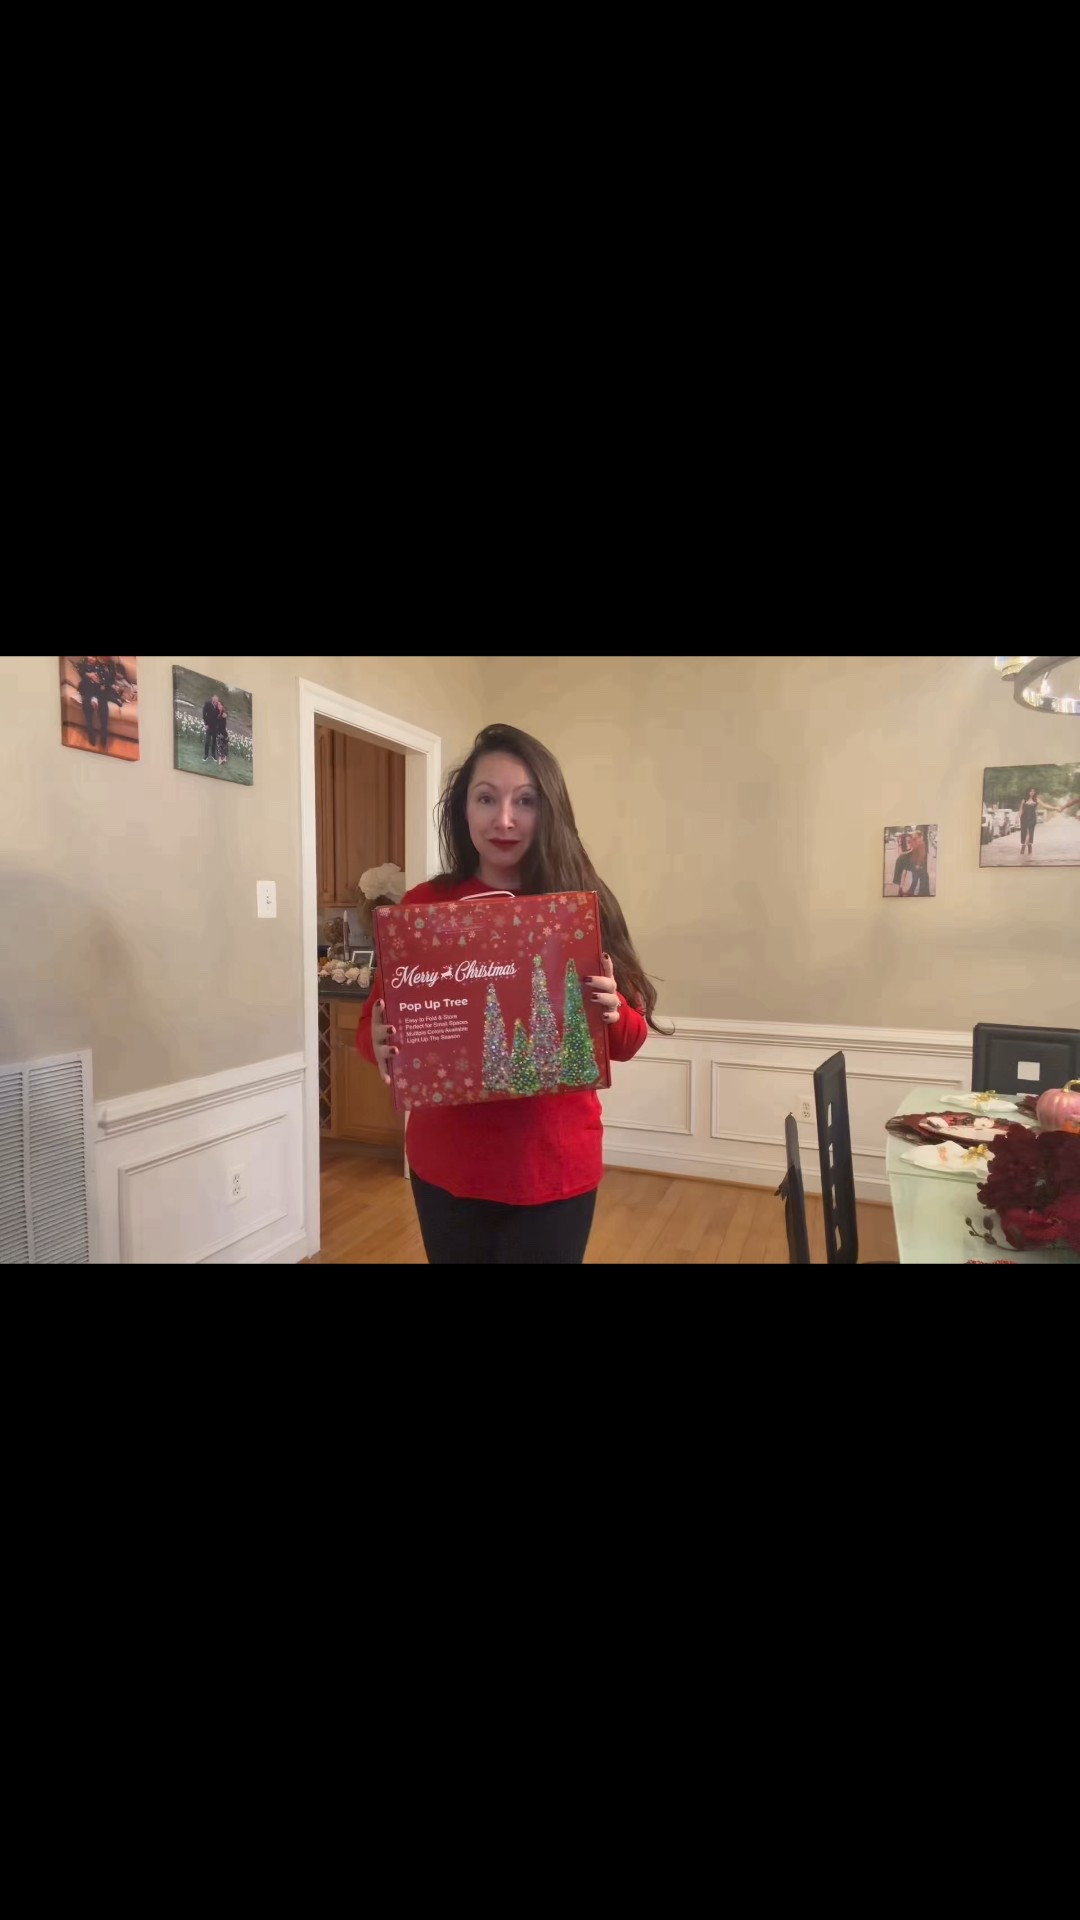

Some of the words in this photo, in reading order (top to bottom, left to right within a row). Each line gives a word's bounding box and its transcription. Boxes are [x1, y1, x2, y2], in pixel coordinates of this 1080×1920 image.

[391, 964, 439, 989] Merry
[454, 959, 517, 982] Christmas
[399, 1002, 421, 1012] Pop
[424, 1000, 441, 1010] Up
[442, 998, 468, 1007] Tree
[425, 1014, 437, 1022] Fold
